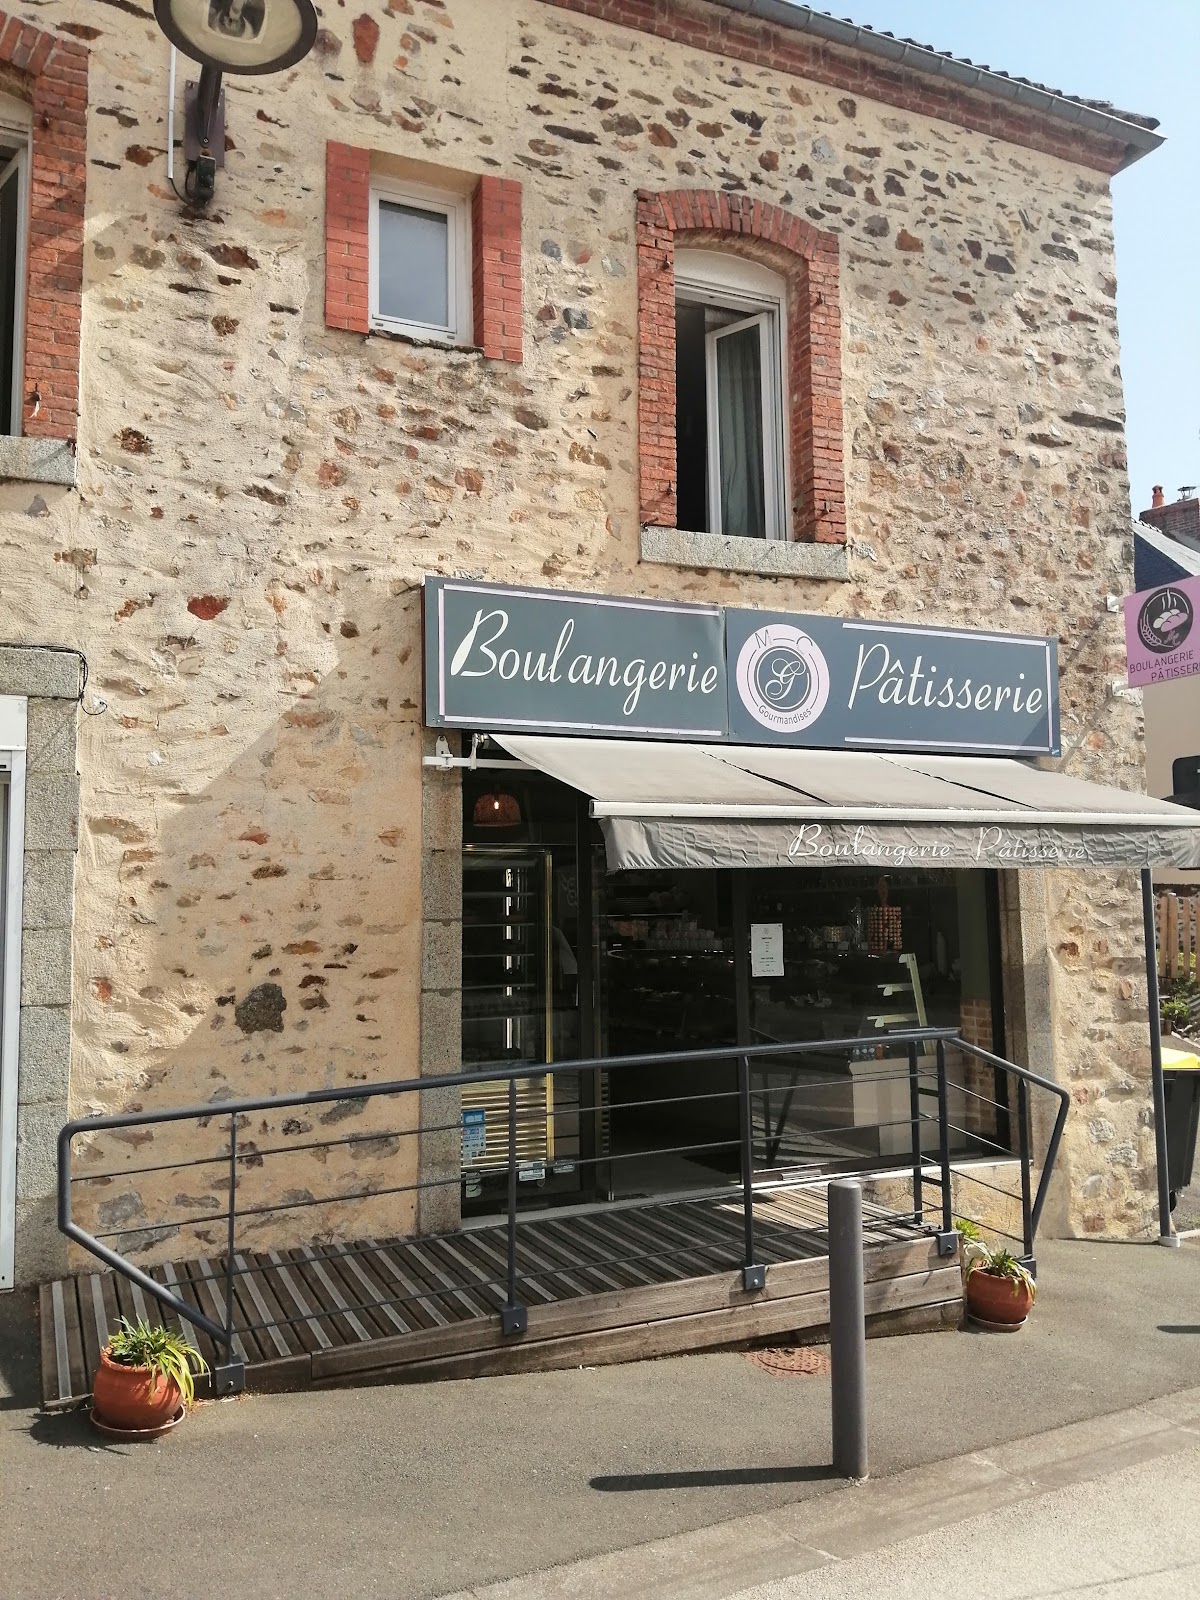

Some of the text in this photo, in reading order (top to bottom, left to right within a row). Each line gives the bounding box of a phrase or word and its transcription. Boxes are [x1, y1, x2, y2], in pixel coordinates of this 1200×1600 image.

[450, 608, 718, 716] Boulangerie
[847, 642, 1043, 714] Pâtisserie
[1129, 649, 1194, 674] BOULANGERIE
[758, 705, 811, 725] Gourmandises
[789, 823, 1087, 866] Boulangerie Pâtisserie
